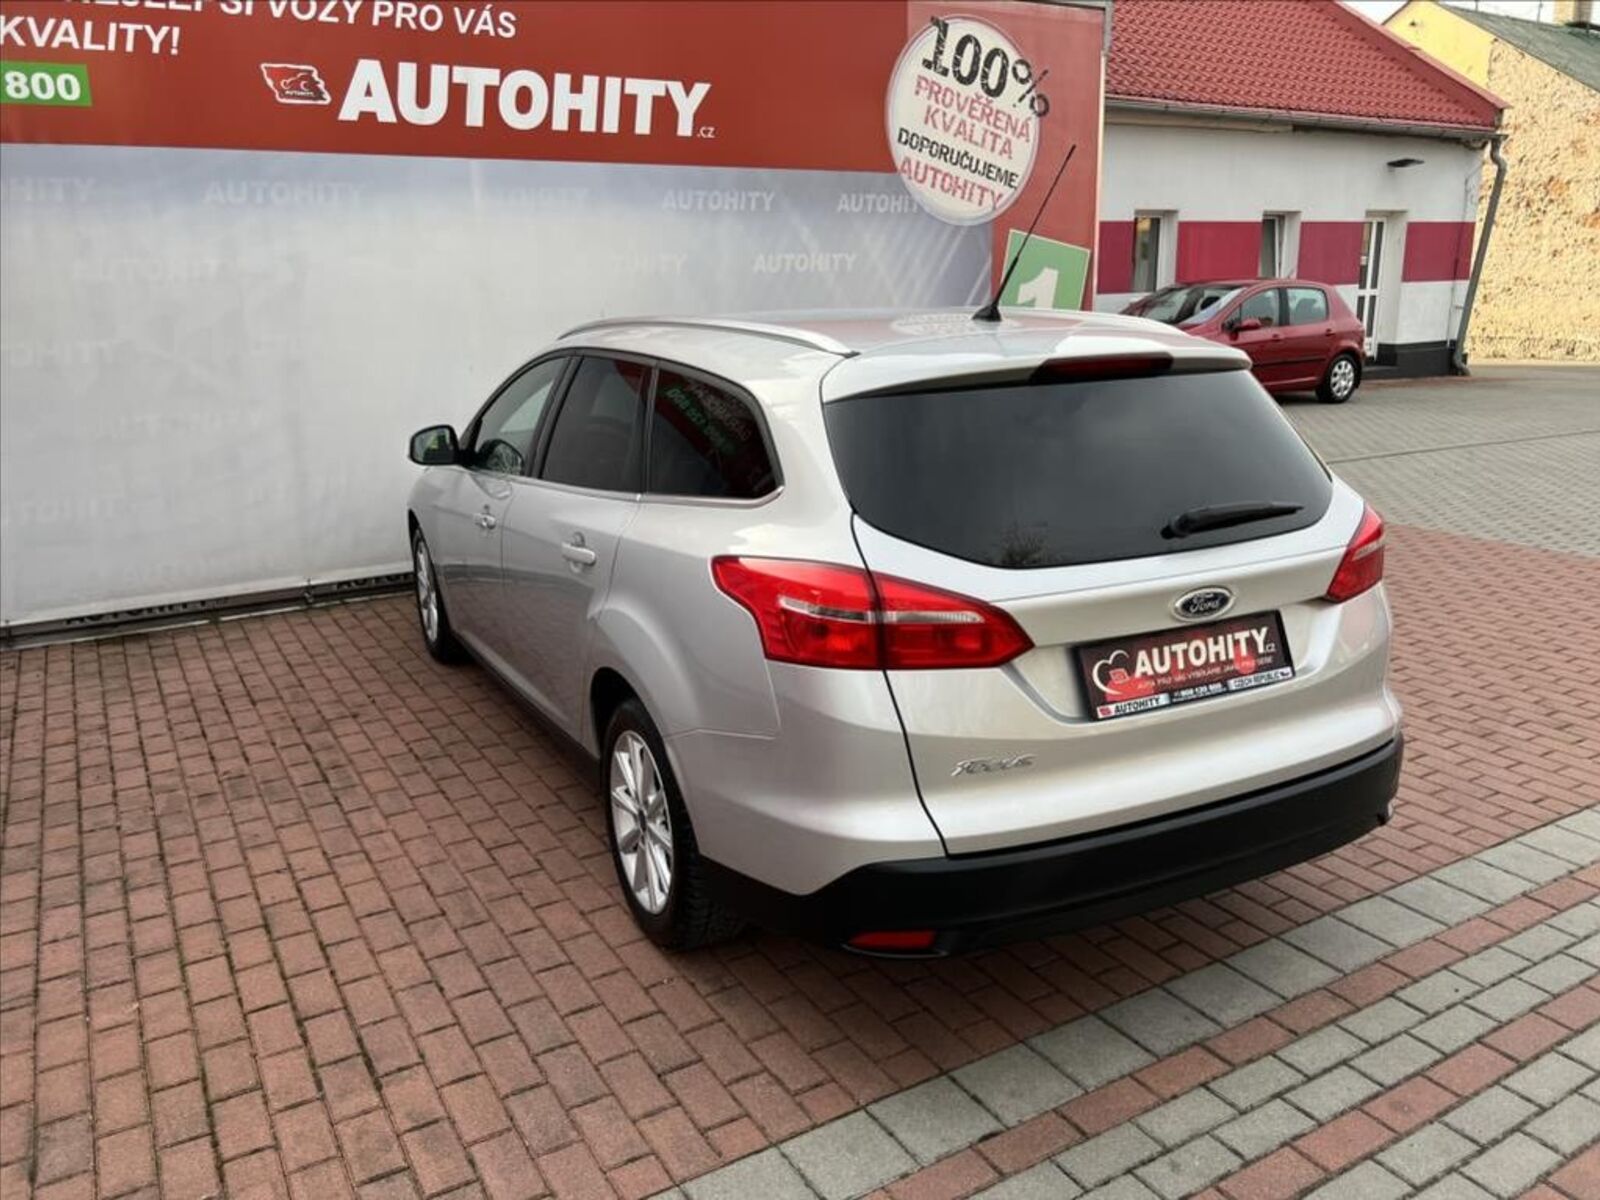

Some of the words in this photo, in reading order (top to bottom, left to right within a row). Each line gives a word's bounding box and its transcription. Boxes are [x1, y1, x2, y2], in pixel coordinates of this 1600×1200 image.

[0, 15, 181, 56] KVALITY!
[268, 0, 364, 25] VOZY
[371, 0, 444, 32] PRO
[453, 4, 517, 38] VÁS
[921, 15, 1050, 118] 100%
[4, 71, 81, 101] 800
[914, 74, 1031, 143] PROVĚŘENÁ
[923, 105, 1013, 160] KVALITA
[897, 127, 1020, 190] DOPORUČUJEME
[203, 180, 366, 205] AUTOHITY
[661, 189, 776, 212] AUTOHITY
[899, 156, 1004, 211] AUTOHITY
[752, 252, 858, 275] AUTOHITY
[1190, 593, 1220, 613] Ford
[1114, 696, 1161, 715] AUTOHITY
